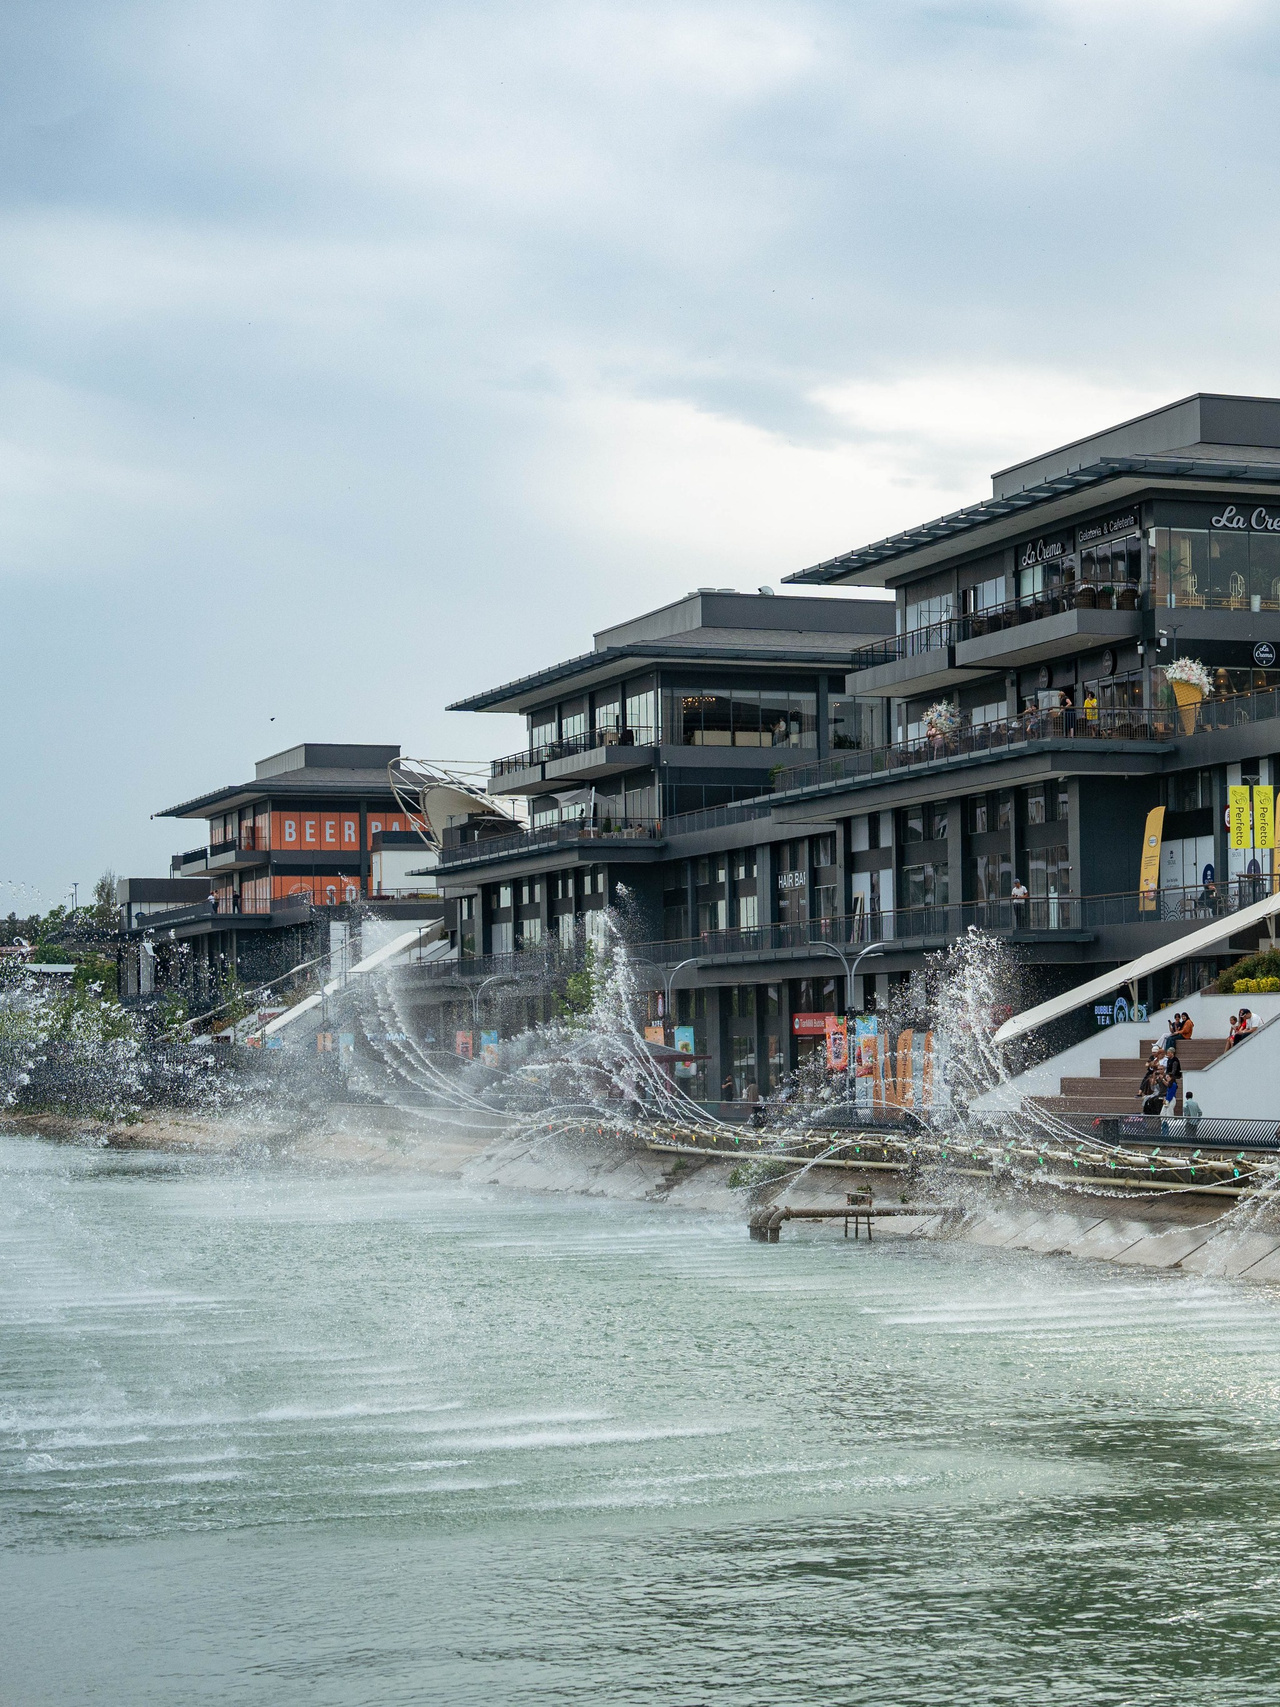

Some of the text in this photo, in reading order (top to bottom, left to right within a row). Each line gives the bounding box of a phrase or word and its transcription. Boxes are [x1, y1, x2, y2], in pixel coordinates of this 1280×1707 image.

[1079, 515, 1135, 542] Gelateria & Cafeteria
[1212, 505, 1247, 529] La
[1022, 539, 1062, 566] La Crema
[284, 820, 356, 842] BEER
[1236, 807, 1244, 846] Perfetto
[1260, 807, 1268, 846] Perfetto
[778, 873, 794, 889] HAIR
[1095, 1005, 1113, 1014] BUBBLE
[1097, 1016, 1111, 1025] TEA
